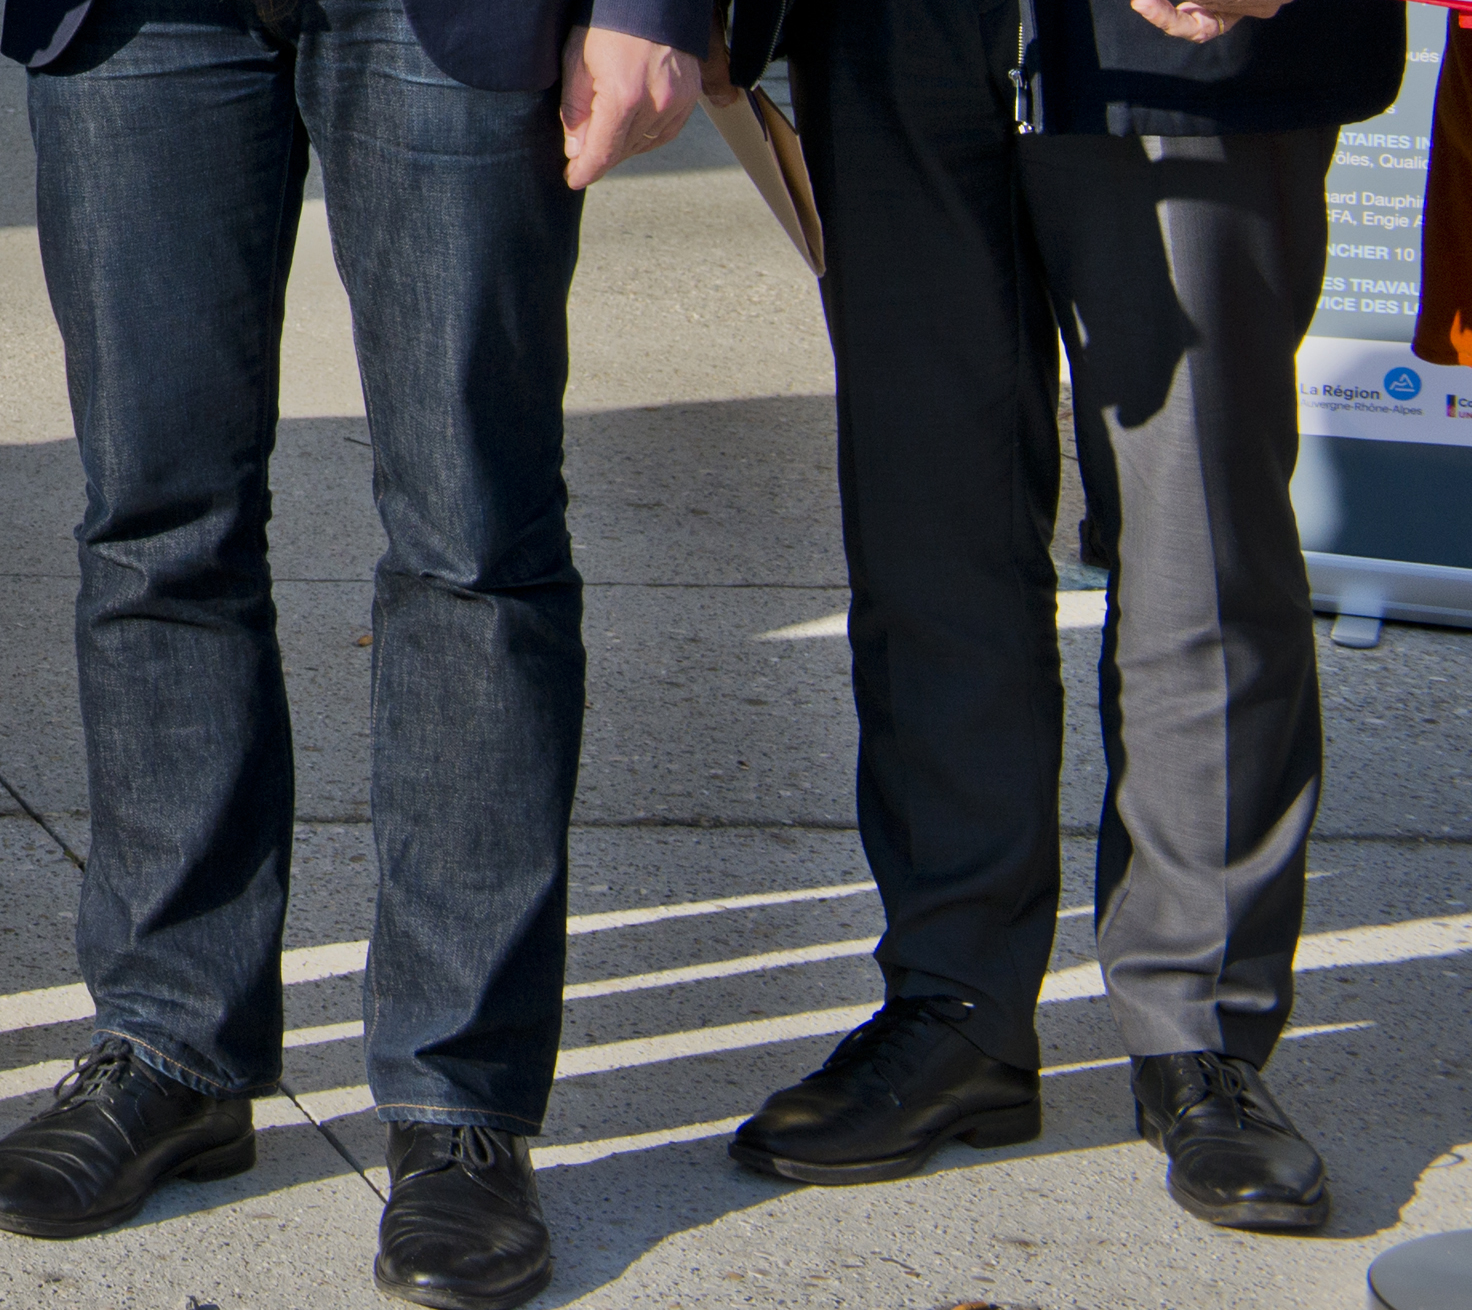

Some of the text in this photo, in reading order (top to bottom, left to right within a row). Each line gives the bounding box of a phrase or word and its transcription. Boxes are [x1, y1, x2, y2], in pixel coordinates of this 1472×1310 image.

[1362, 211, 1409, 230] Engie
[1395, 247, 1415, 262] 10
[1360, 298, 1399, 314] DES
[1300, 383, 1381, 401] La Région
